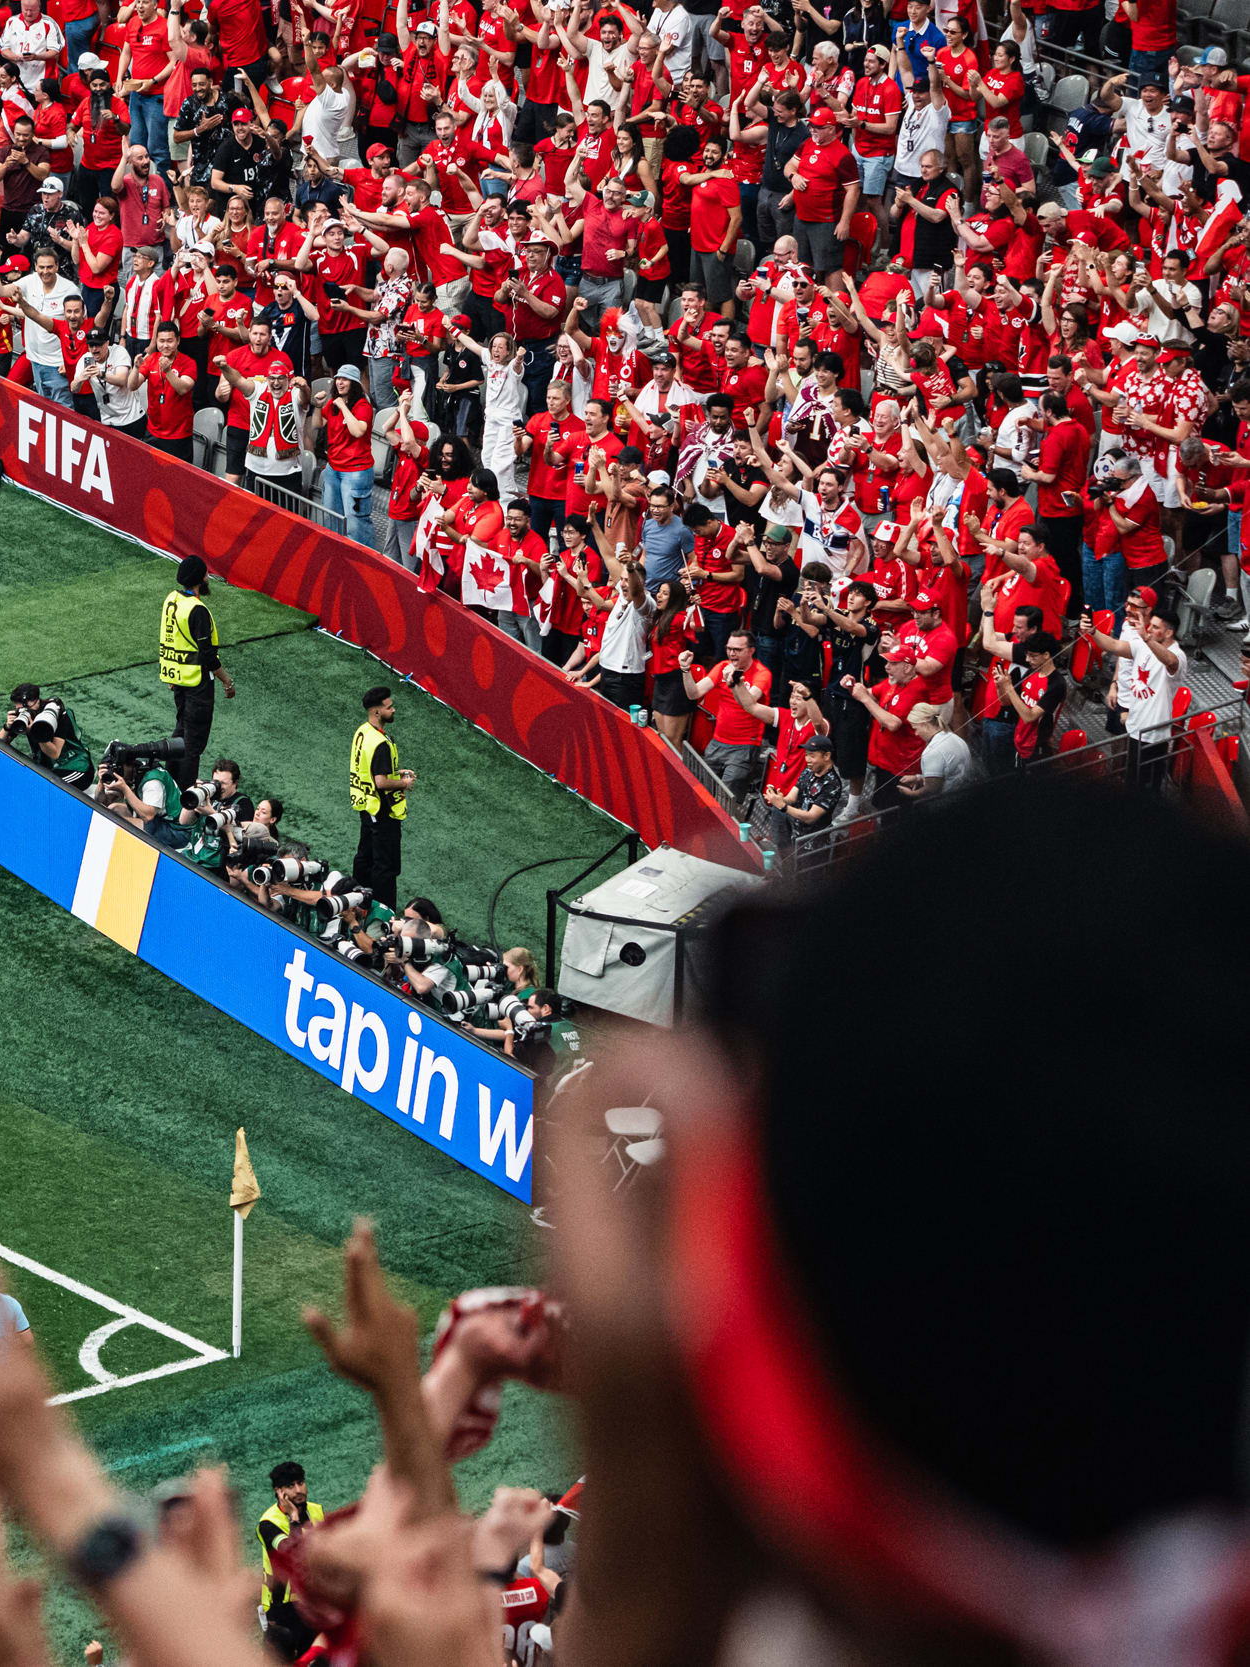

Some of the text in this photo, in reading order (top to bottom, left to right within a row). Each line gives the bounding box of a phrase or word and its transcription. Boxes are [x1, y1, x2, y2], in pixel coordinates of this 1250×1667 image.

[18, 399, 115, 505] FIFA
[283, 948, 390, 1094] tap
[396, 1011, 459, 1141] in
